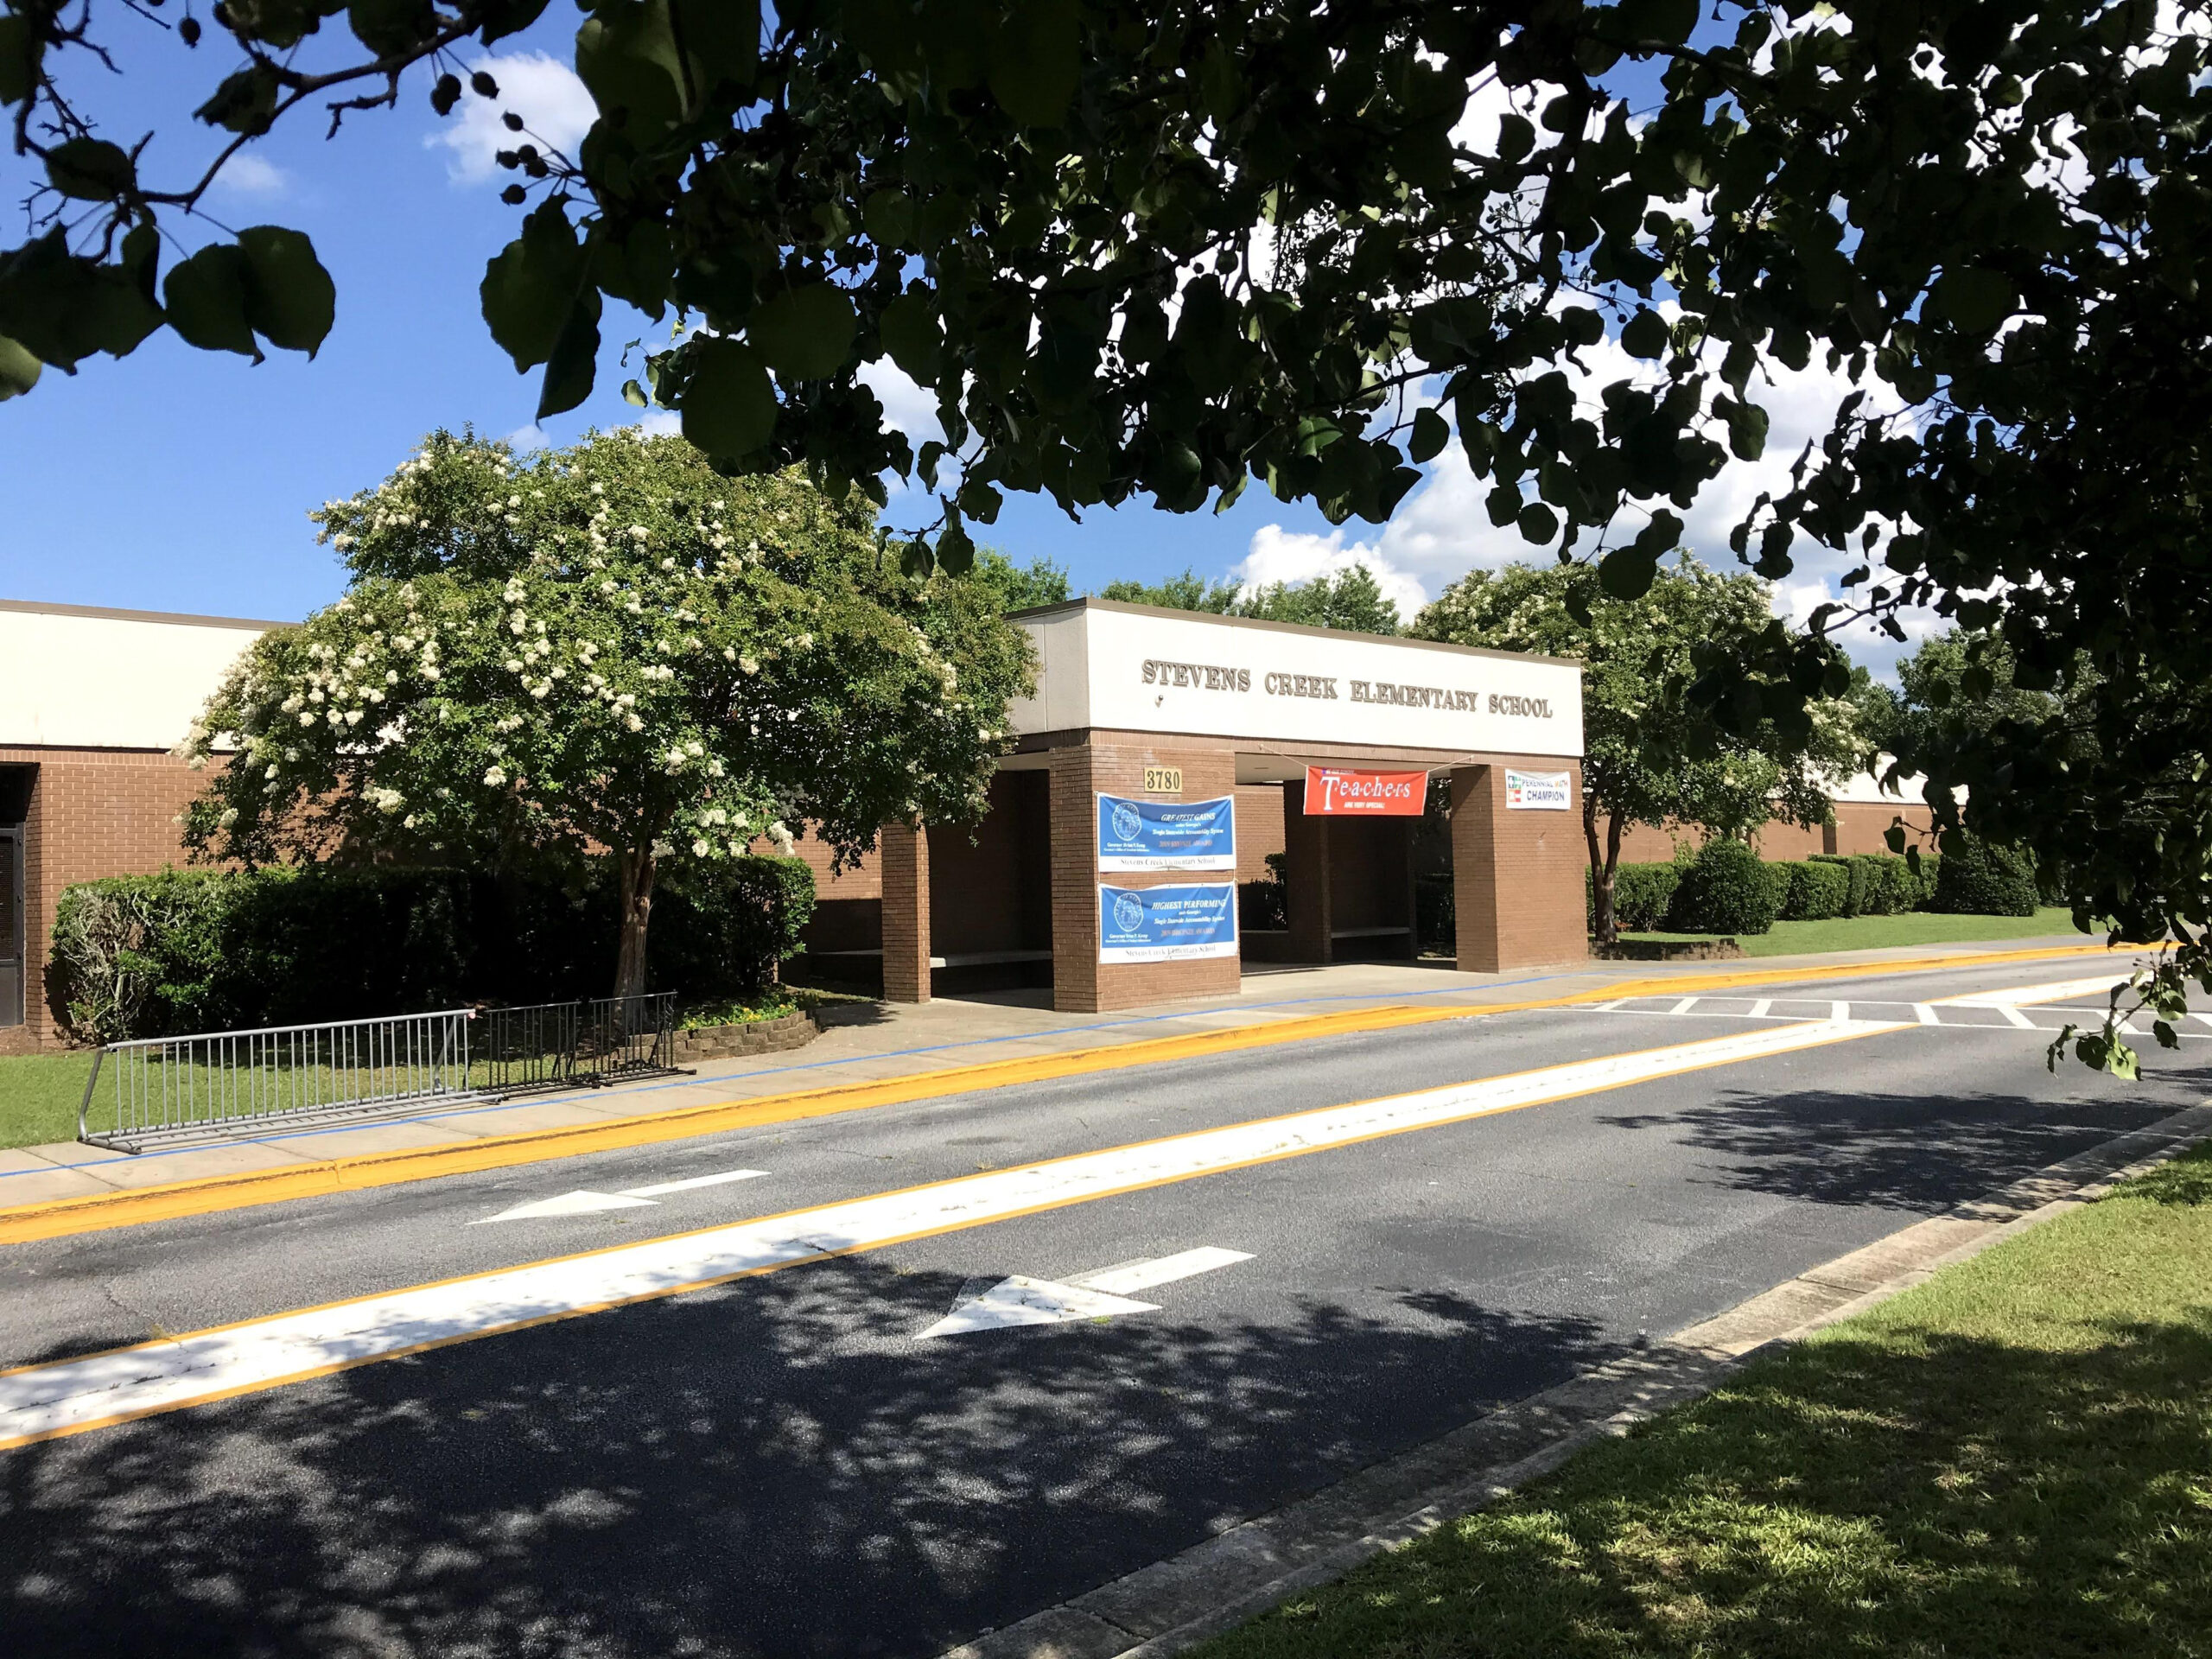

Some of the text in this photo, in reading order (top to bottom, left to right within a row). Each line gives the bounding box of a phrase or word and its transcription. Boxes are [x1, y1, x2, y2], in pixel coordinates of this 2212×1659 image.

[1141, 659, 1553, 718] STEVENS CREEK ELEMENTARY SCHOOL
[1147, 770, 1180, 789] 3780
[1522, 779, 1568, 788] PERENNIAL MATH
[1319, 776, 1411, 810] Teachers
[1527, 790, 1565, 801] CHAMPION
[1194, 812, 1217, 821] GAINS
[1152, 899, 1226, 910] HIGHEST PERFORMING
